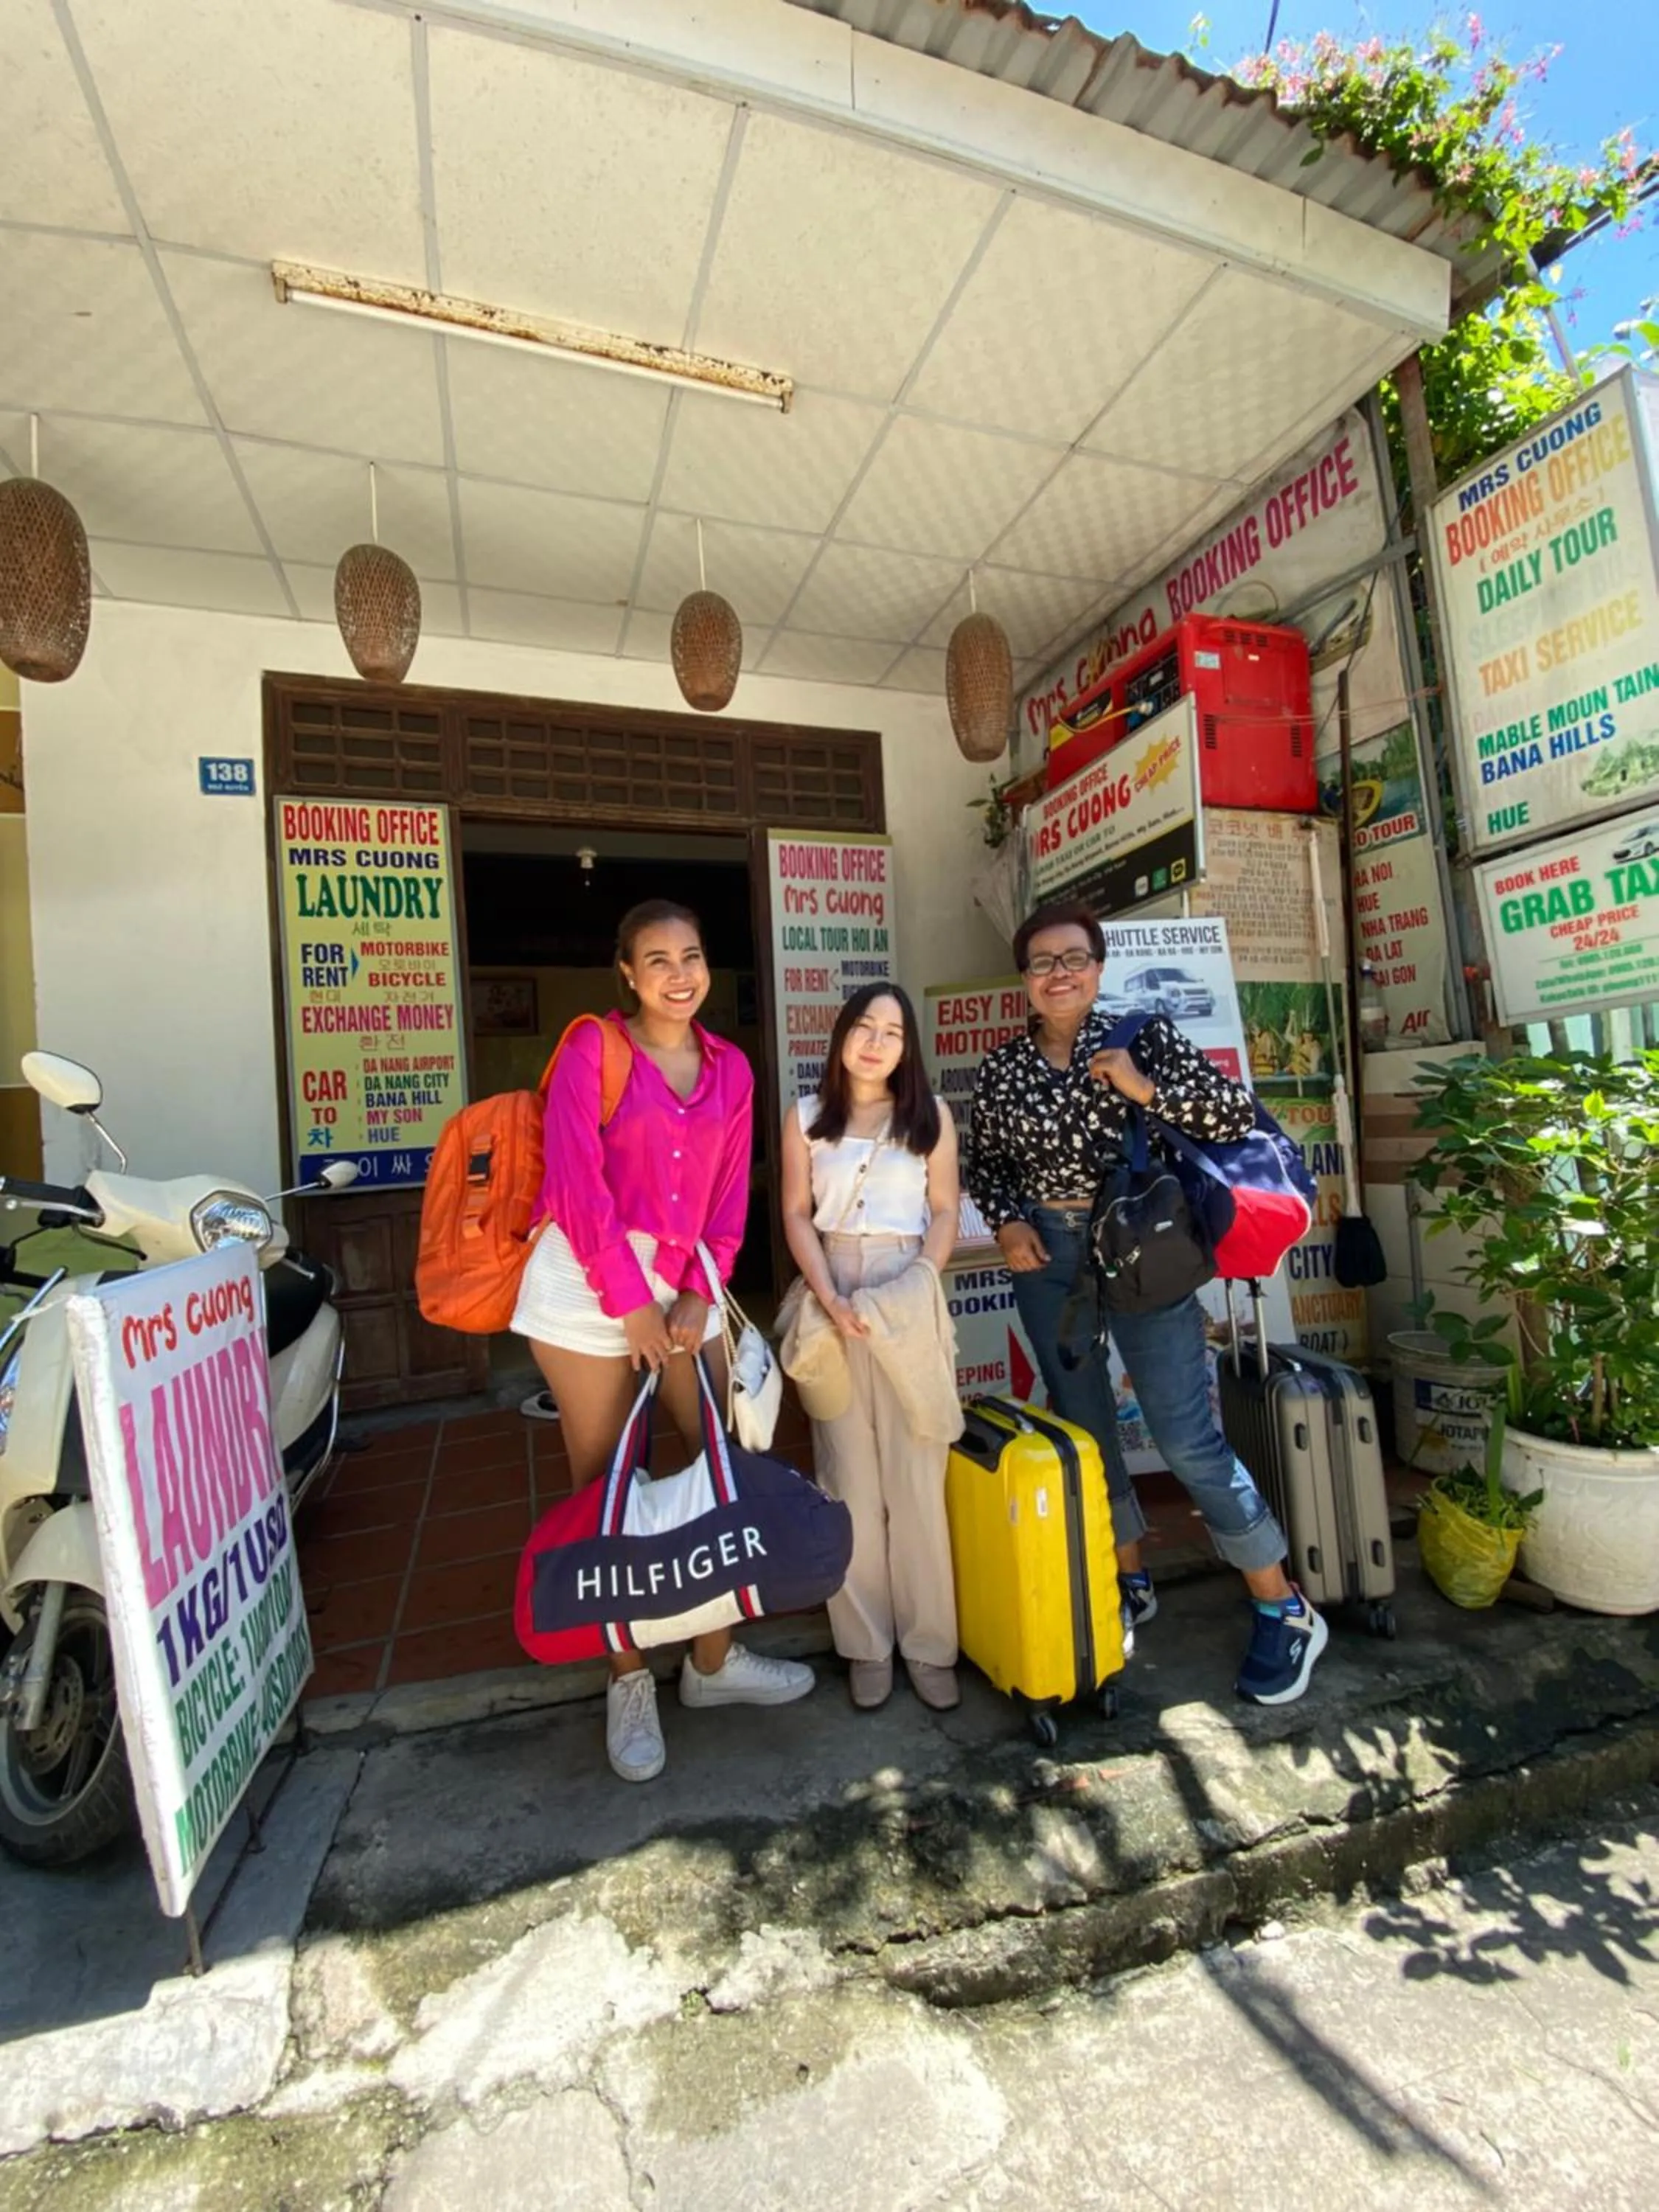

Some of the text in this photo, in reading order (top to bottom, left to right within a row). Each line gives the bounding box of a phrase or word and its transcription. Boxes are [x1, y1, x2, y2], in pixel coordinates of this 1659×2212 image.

[1458, 402, 1601, 512] MRS CUONG
[1445, 414, 1630, 566] BOOKING OFFICE
[1166, 515, 1262, 624] BOOKING
[1265, 437, 1359, 549] OFFICE
[1476, 506, 1618, 615] DAILY TOUR
[1478, 590, 1643, 696] TAXI SERVICE
[1477, 714, 1543, 759] MABLE
[1547, 685, 1609, 731] MOUN
[1481, 714, 1615, 785] BANA HILLS
[206, 762, 248, 782] 138
[1043, 763, 1108, 820] BOOKING OFFICE
[1067, 774, 1131, 838] CUONG
[1487, 802, 1530, 835] HUE
[283, 804, 439, 846] BOOKING OFFICE
[1371, 814, 1415, 841] TOUR
[289, 848, 439, 869] MRS CUONG
[779, 844, 886, 883] BOOKING OFFICE
[1371, 862, 1393, 883] NOI
[1495, 856, 1581, 895] BOOK HERE
[296, 873, 443, 919] LAUNDRY
[785, 884, 884, 925] Mrs Cuong
[1357, 892, 1380, 913] HUE
[1500, 878, 1595, 934] GRAB
[1105, 925, 1221, 947] HUTTLE SERVICE
[1361, 908, 1428, 937] NHA TRANG
[1551, 905, 1639, 939] CHEAP PRICE
[361, 942, 449, 956] MOTORBIKE
[782, 926, 888, 952] LOCAL TOUR HOI AN
[1384, 940, 1402, 960] LAT
[1573, 927, 1620, 951] 24/24
[301, 943, 344, 964] FOR
[302, 967, 349, 987] RENT
[369, 973, 447, 987] BICYCLE
[785, 967, 829, 992] FOR RENT
[841, 960, 889, 977] MOTORBIKE
[1371, 964, 1416, 990] SAI GON
[301, 1004, 453, 1034] EXCHANGE MONEY
[938, 995, 993, 1026] EASY
[788, 1040, 827, 1057] PRIVATE
[363, 1055, 454, 1074] DA NANG AIRPORT
[302, 1070, 347, 1102] CAR
[364, 1074, 449, 1091] DA NANG CITY
[366, 1091, 442, 1108] BANA HILL
[311, 1107, 337, 1124] TO
[366, 1108, 422, 1125] MY SON
[1287, 1106, 1335, 1125] TOU
[307, 1127, 333, 1148] 차
[368, 1127, 400, 1144] HUE
[1289, 1244, 1332, 1280] CITY
[955, 1268, 1012, 1291] MRS
[1293, 1290, 1362, 1325] ANCTUARY
[122, 1275, 254, 1369] Mrs Cuong
[119, 1325, 282, 1610] LAUNDRY
[577, 1526, 768, 1600] HILFIGER
